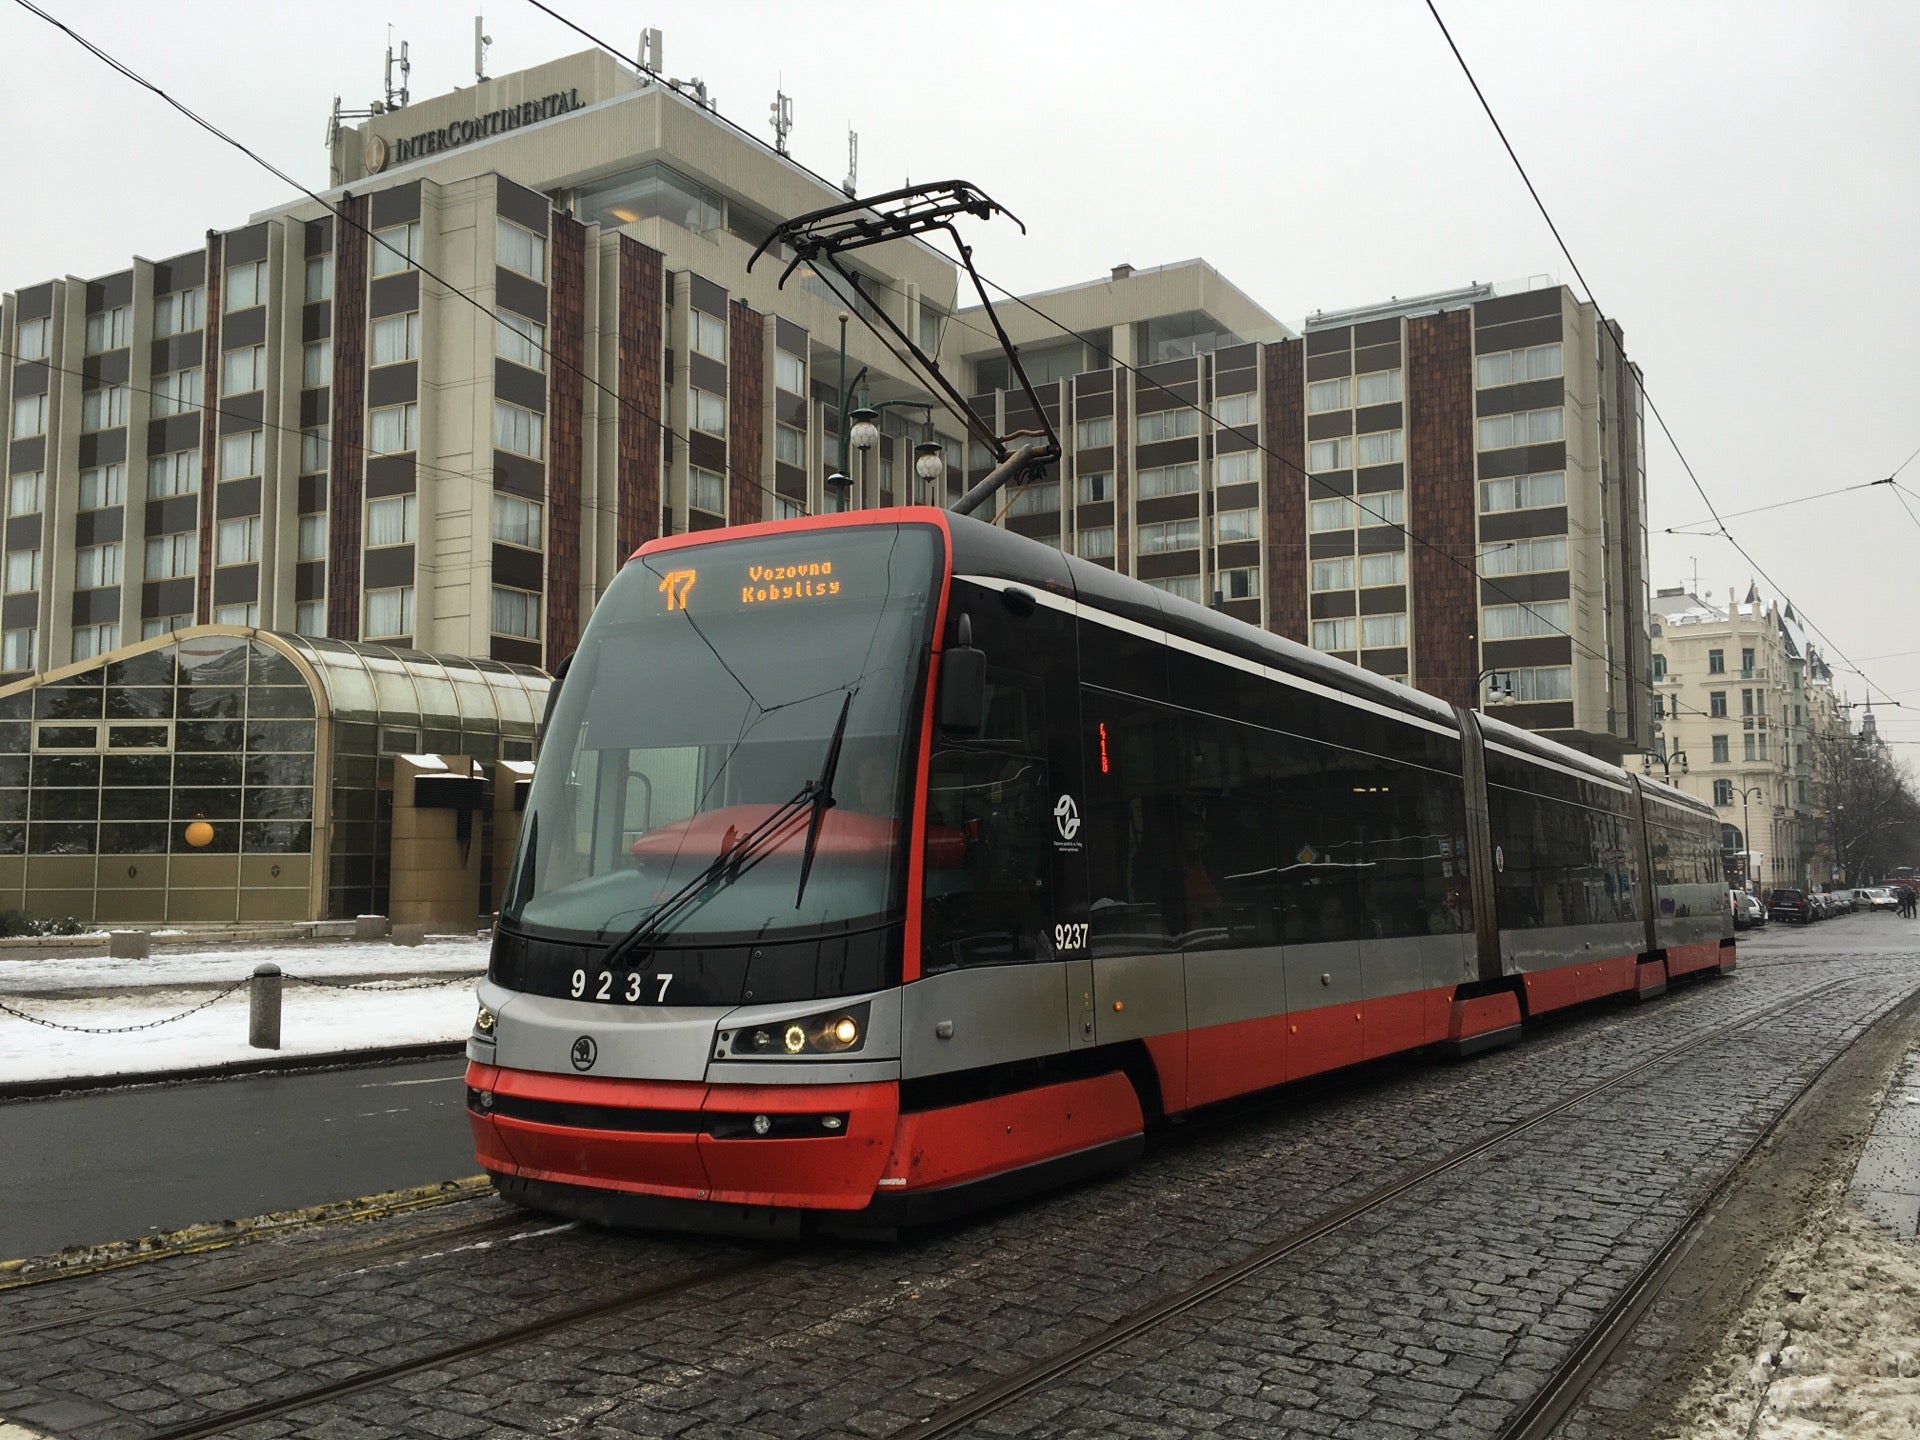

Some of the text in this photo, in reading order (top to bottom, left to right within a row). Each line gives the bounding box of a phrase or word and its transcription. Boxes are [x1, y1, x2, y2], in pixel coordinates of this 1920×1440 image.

[749, 562, 832, 582] Vozovna
[659, 569, 696, 611] 17
[742, 581, 840, 603] Kobylisy
[1055, 924, 1089, 950] 9237
[571, 969, 673, 1002] 9237
